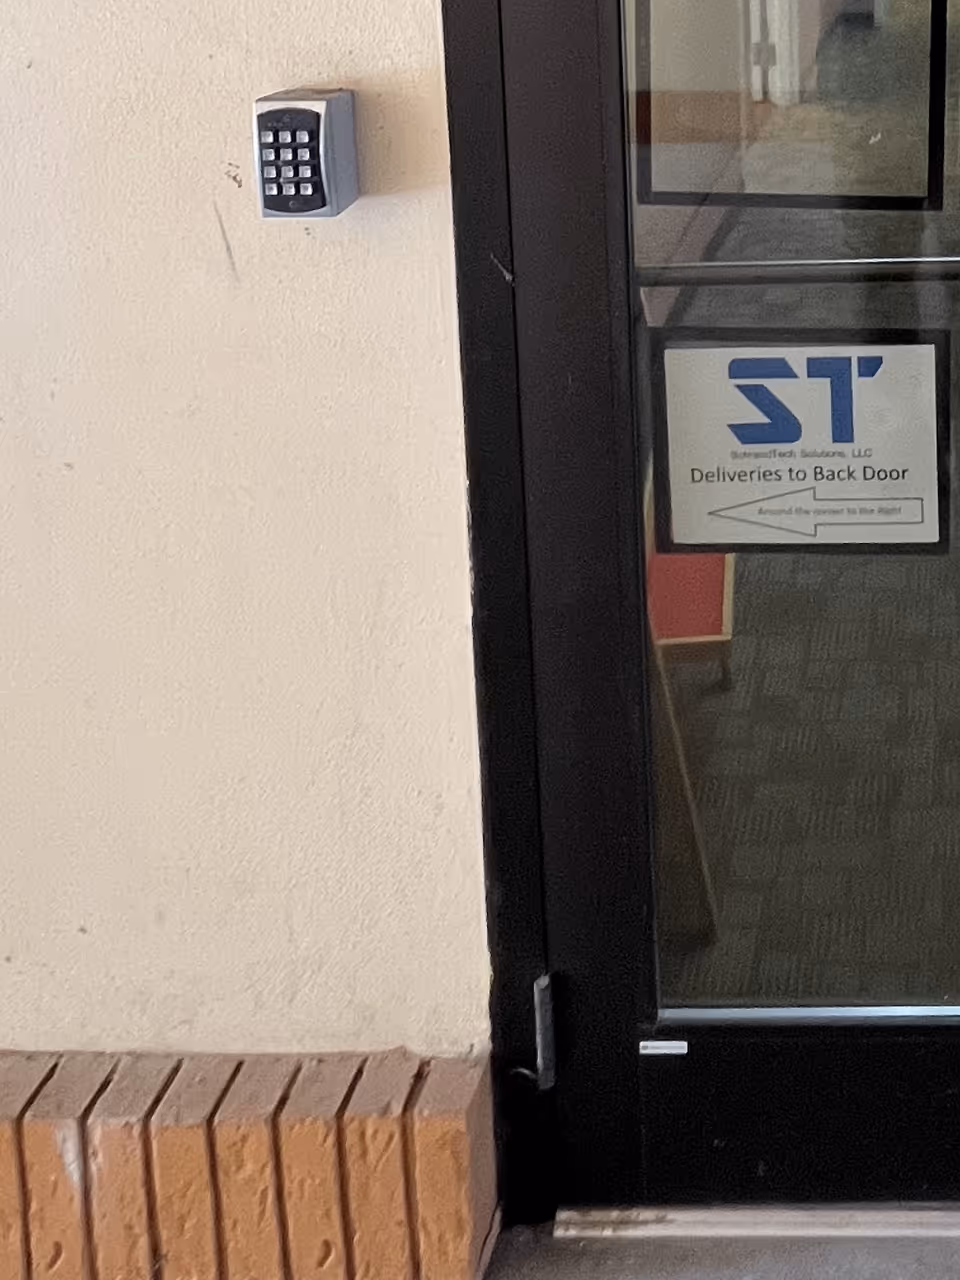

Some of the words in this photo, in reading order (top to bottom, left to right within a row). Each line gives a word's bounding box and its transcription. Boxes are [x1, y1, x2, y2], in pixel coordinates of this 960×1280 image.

[726, 355, 884, 445] ST
[690, 466, 783, 483] Deliveries
[788, 467, 807, 482] to
[813, 465, 856, 482] Back
[863, 465, 910, 481] Door
